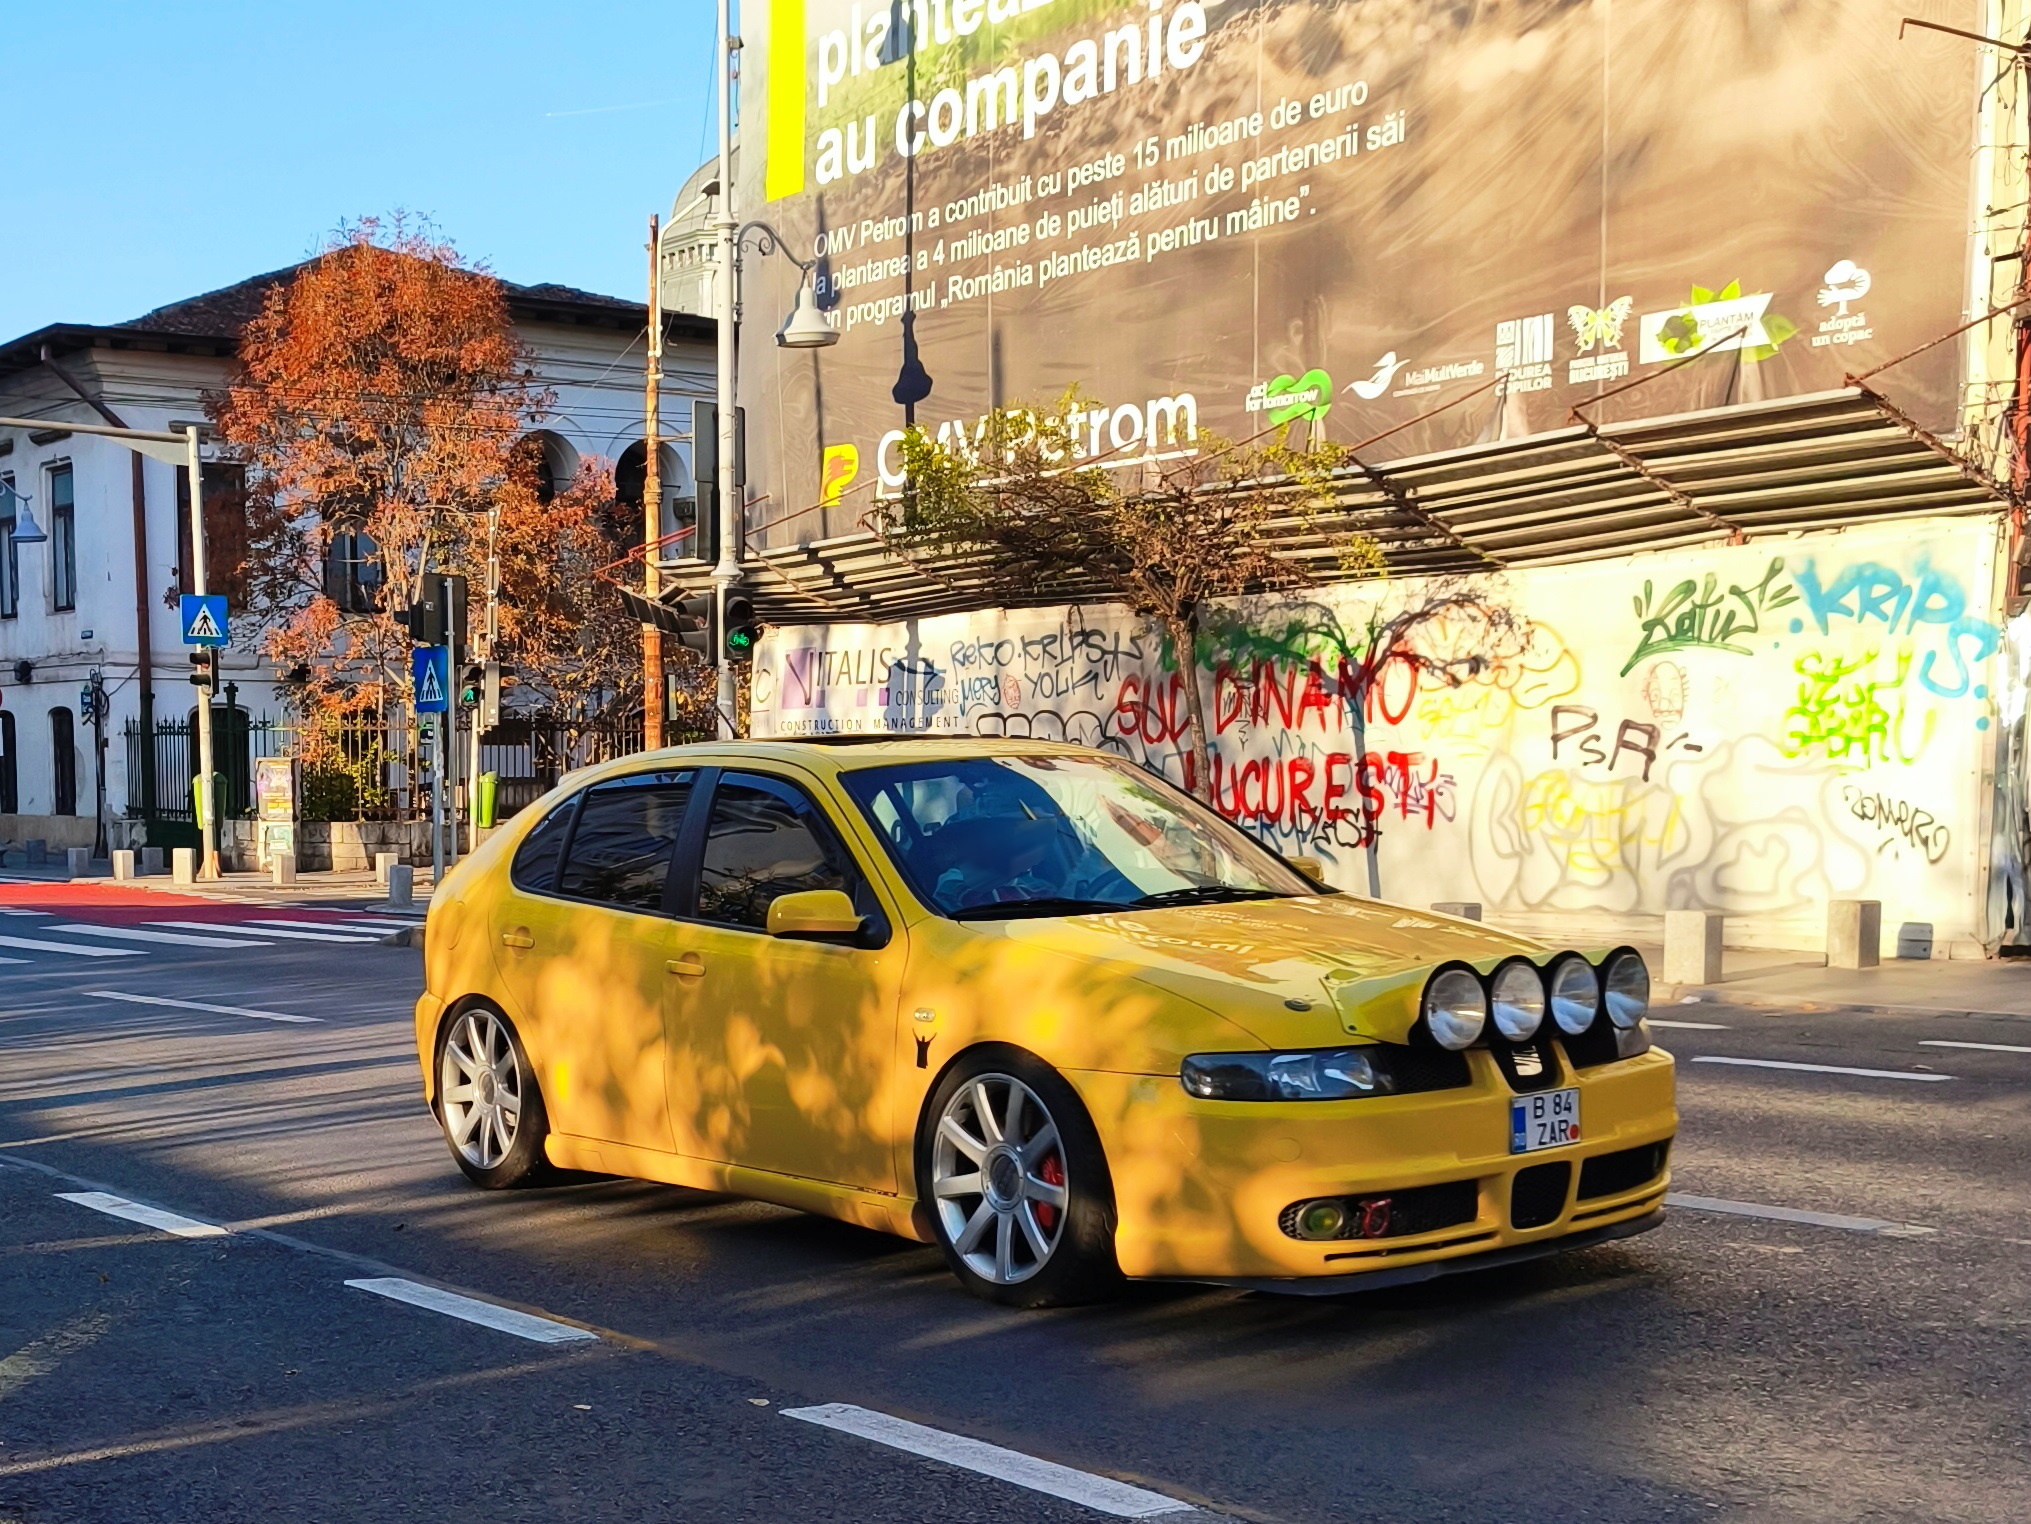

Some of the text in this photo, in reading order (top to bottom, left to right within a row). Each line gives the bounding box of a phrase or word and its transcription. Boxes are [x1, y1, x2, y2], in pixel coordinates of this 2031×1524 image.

[814, 0, 1208, 185] au companie
[814, 80, 1369, 258] OMV Petrom a contribuit cu peste 15 milioane de euro
[812, 271, 827, 295] la
[831, 254, 911, 298] plantarea
[916, 249, 928, 271] a
[932, 239, 945, 265] 4
[950, 225, 1030, 262] milioane
[1035, 211, 1061, 241] de
[1129, 169, 1198, 216] alături
[1205, 163, 1235, 195] de
[1241, 123, 1358, 192] partenerii
[1366, 110, 1406, 150] săi
[846, 281, 936, 332] programul
[1039, 232, 1141, 288] plantează
[1147, 215, 1219, 262] pentru
[1811, 328, 1873, 346] un copac
[785, 647, 892, 706] VITALIS
[895, 688, 959, 706] CONSULTING
[780, 718, 862, 732] CONSTRUCTION
[873, 716, 959, 730] MANAGEMENT
[1533, 1092, 1572, 1119] B 84
[1537, 1119, 1570, 1146] ZAR
